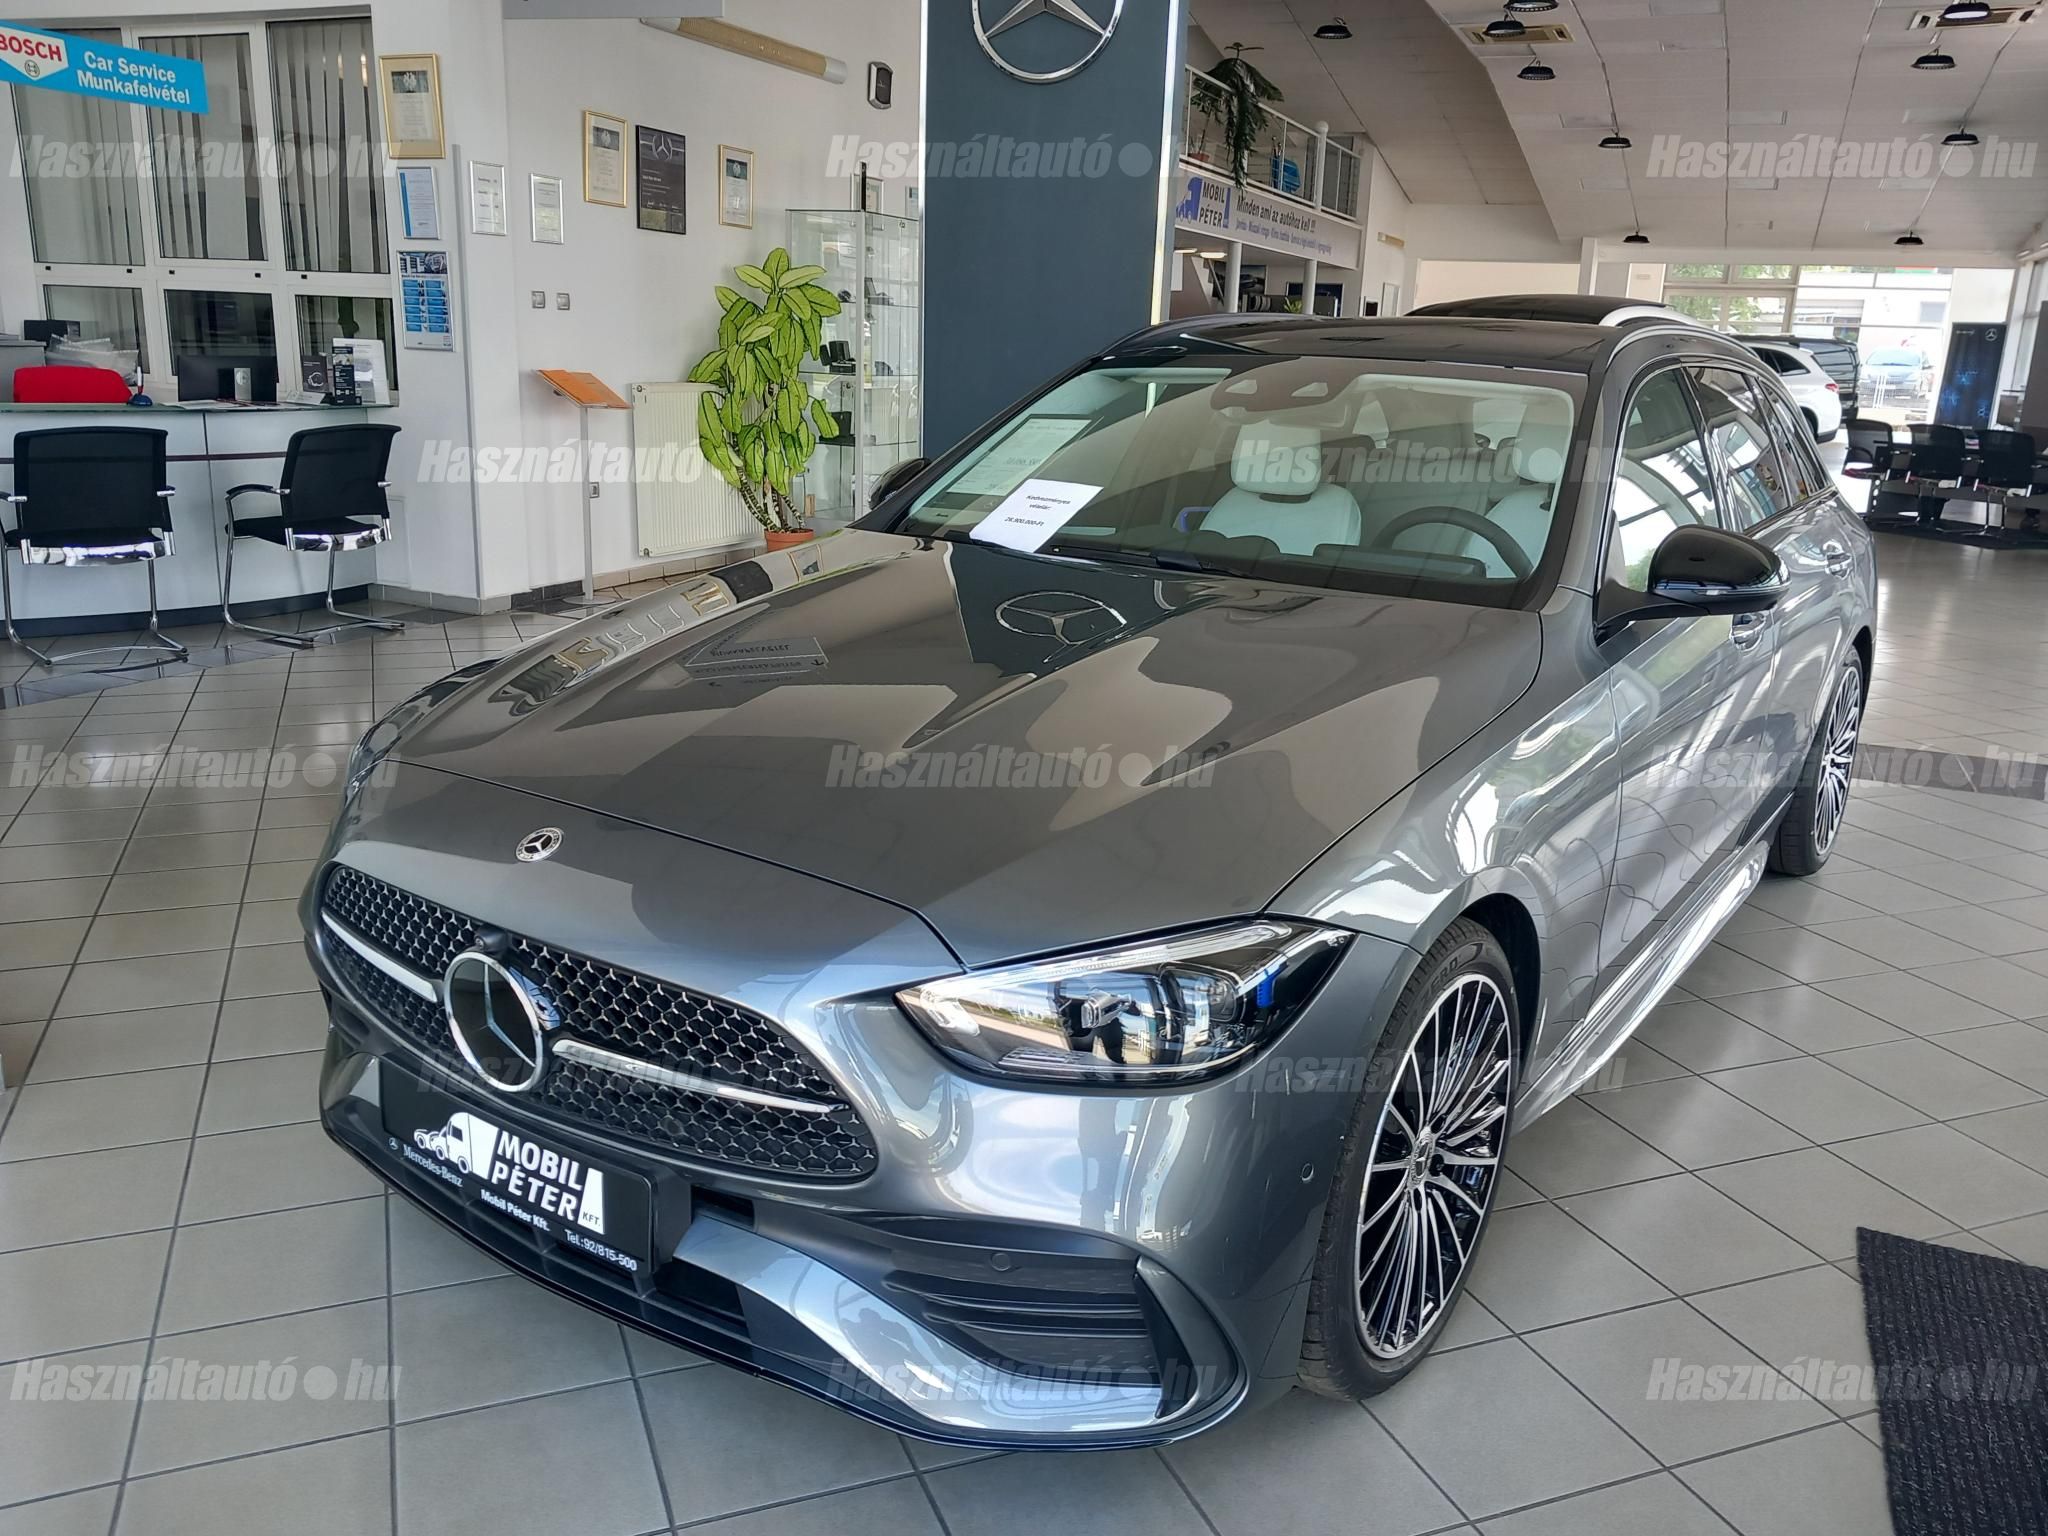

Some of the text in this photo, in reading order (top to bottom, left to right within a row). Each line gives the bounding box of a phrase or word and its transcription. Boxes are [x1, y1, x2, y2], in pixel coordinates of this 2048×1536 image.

[0, 33, 62, 62] BOSCH
[84, 51, 177, 83] Car Service
[77, 70, 191, 105] Munkafelvétel
[1203, 181, 1226, 204] MOBIL
[1199, 204, 1223, 228] PÉTER
[1237, 195, 1260, 217] Minden
[1260, 205, 1272, 220] ami
[1272, 210, 1279, 223] az
[1279, 211, 1300, 230] autóhoz
[1300, 216, 1311, 232] kell
[403, 1144, 463, 1187] Mercedes-Benz
[497, 1130, 583, 1191] MOBIL
[491, 1160, 578, 1221] PÉTER
[480, 1188, 551, 1232] Mobil Péter Kft.
[582, 1211, 601, 1227] KFT.
